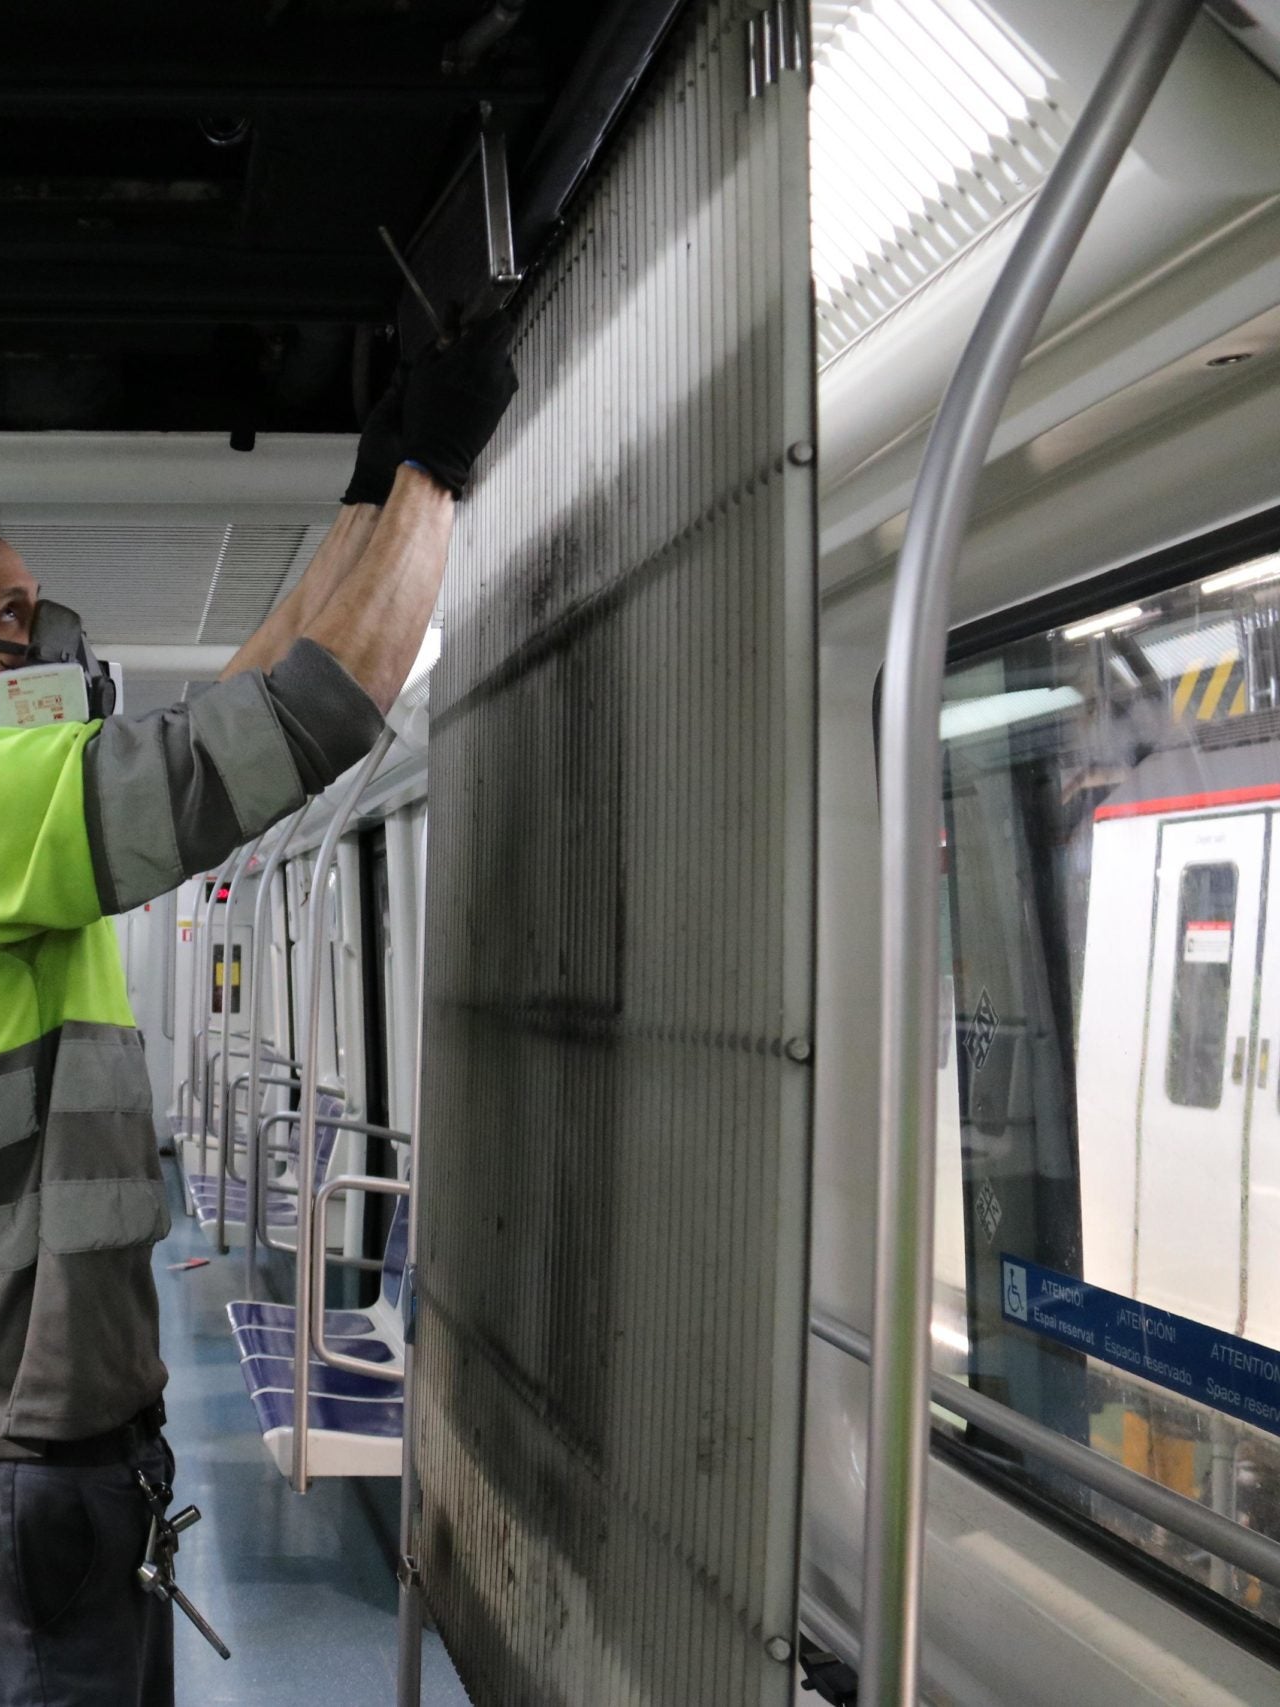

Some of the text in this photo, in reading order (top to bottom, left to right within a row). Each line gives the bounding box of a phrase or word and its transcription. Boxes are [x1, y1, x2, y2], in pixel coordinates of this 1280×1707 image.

[1041, 1279, 1084, 1308] ATENCIÓ!
[1033, 1306, 1095, 1346] Espai reservat
[1116, 1308, 1177, 1344] ¡ATENCIÓN!
[1104, 1335, 1193, 1387] Espacio reservado
[1206, 1376, 1241, 1405] Space
